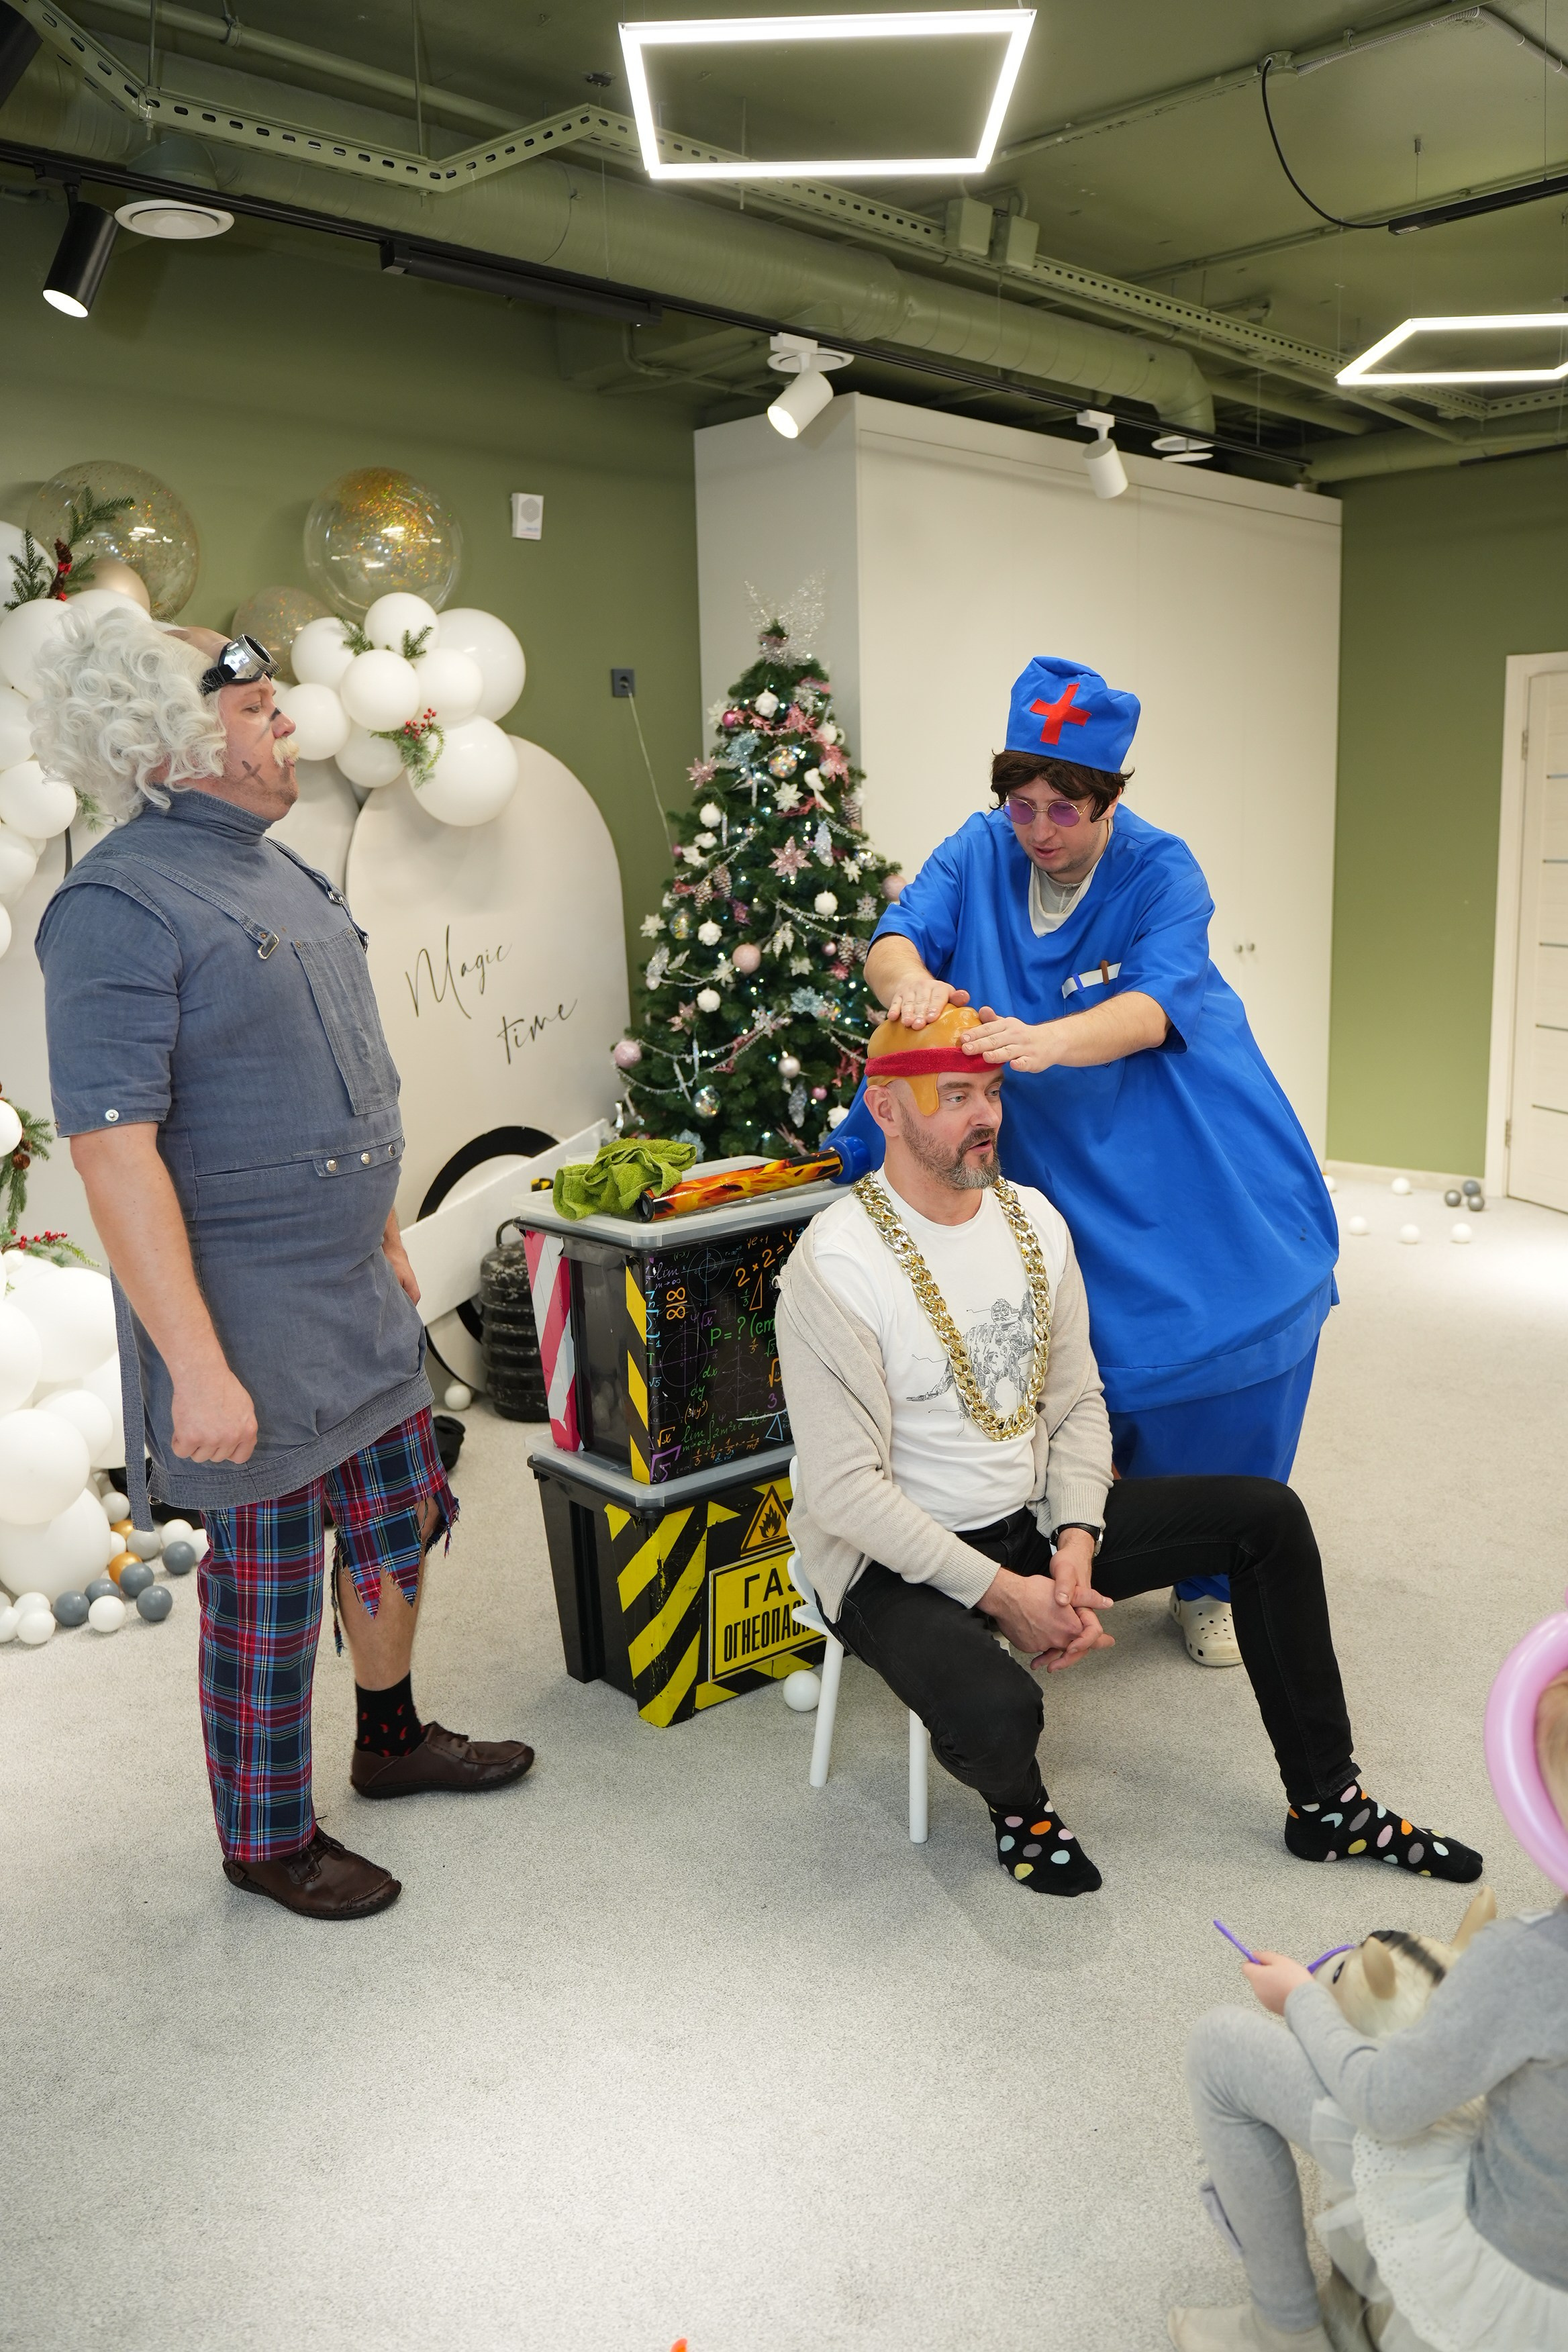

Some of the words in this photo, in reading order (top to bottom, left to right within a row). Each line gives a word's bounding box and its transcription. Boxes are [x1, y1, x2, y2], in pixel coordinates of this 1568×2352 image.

[405, 924, 512, 1020] Magic
[497, 998, 578, 1065] time
[744, 1567, 797, 1609] ГА
